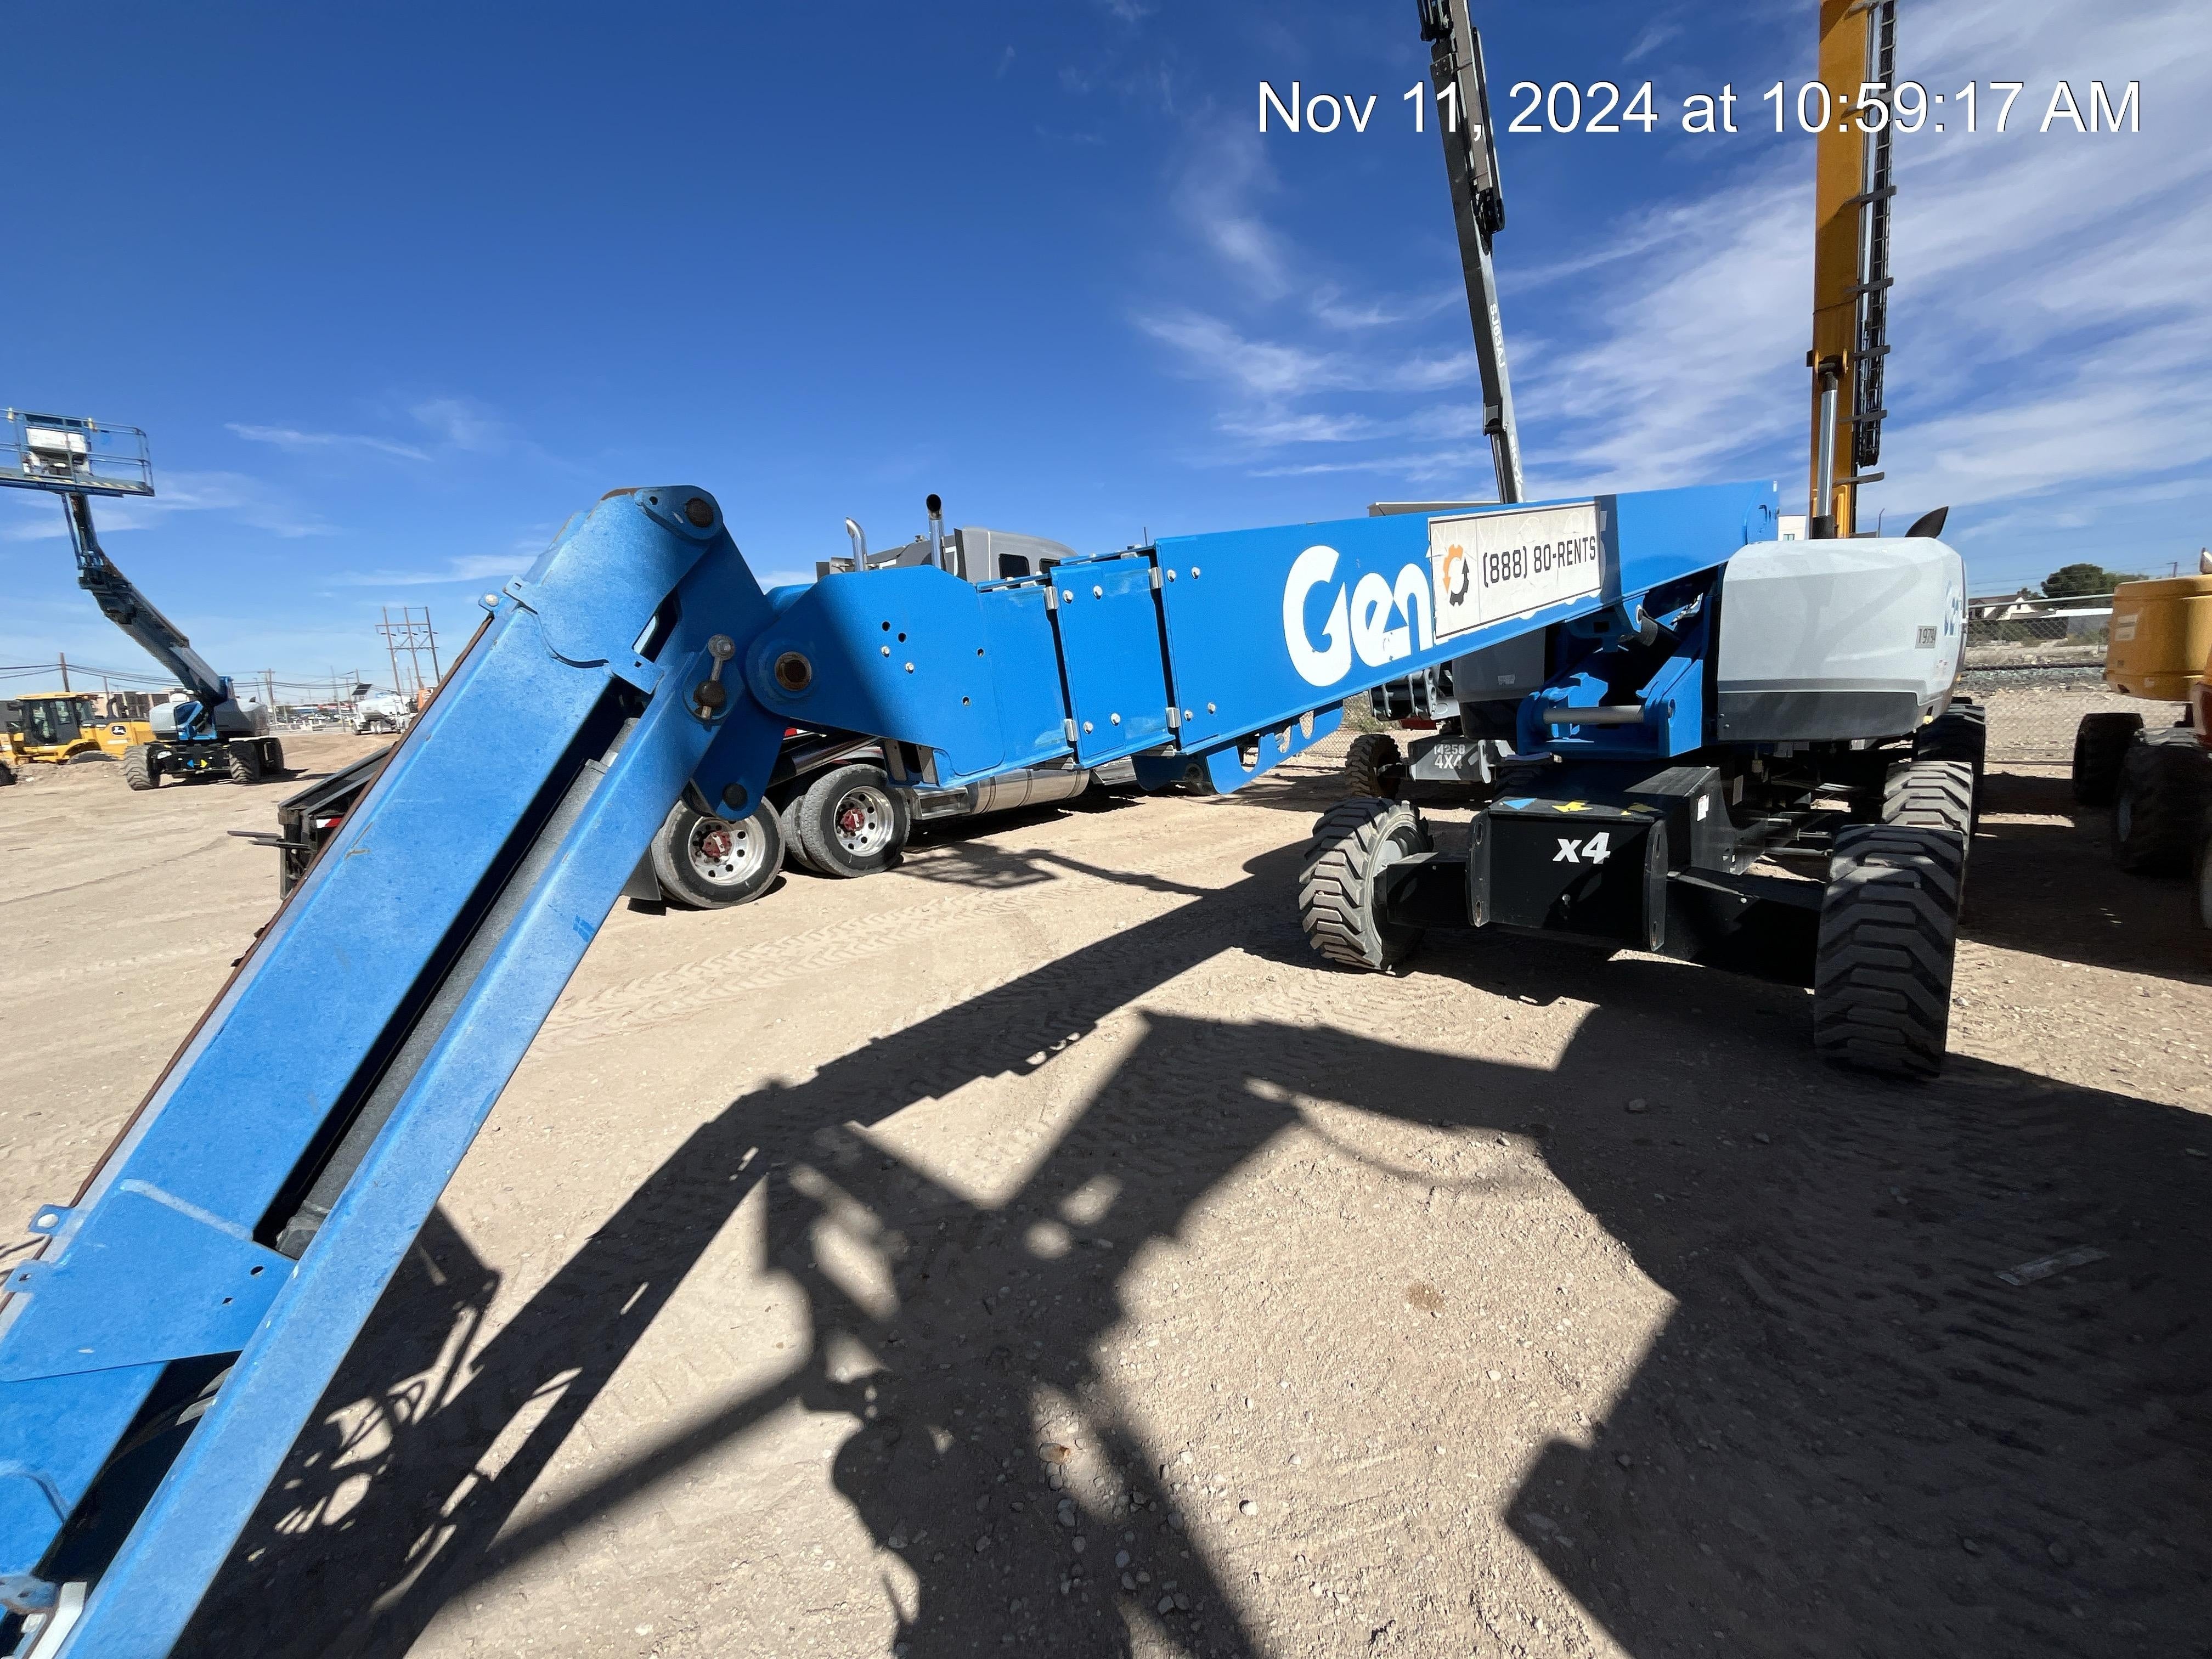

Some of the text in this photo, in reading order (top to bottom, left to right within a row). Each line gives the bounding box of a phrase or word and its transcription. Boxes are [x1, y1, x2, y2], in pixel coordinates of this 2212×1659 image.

[1489, 303, 1506, 368] SJ63AJ
[1483, 535, 1596, 588] (888) 80-RENTS
